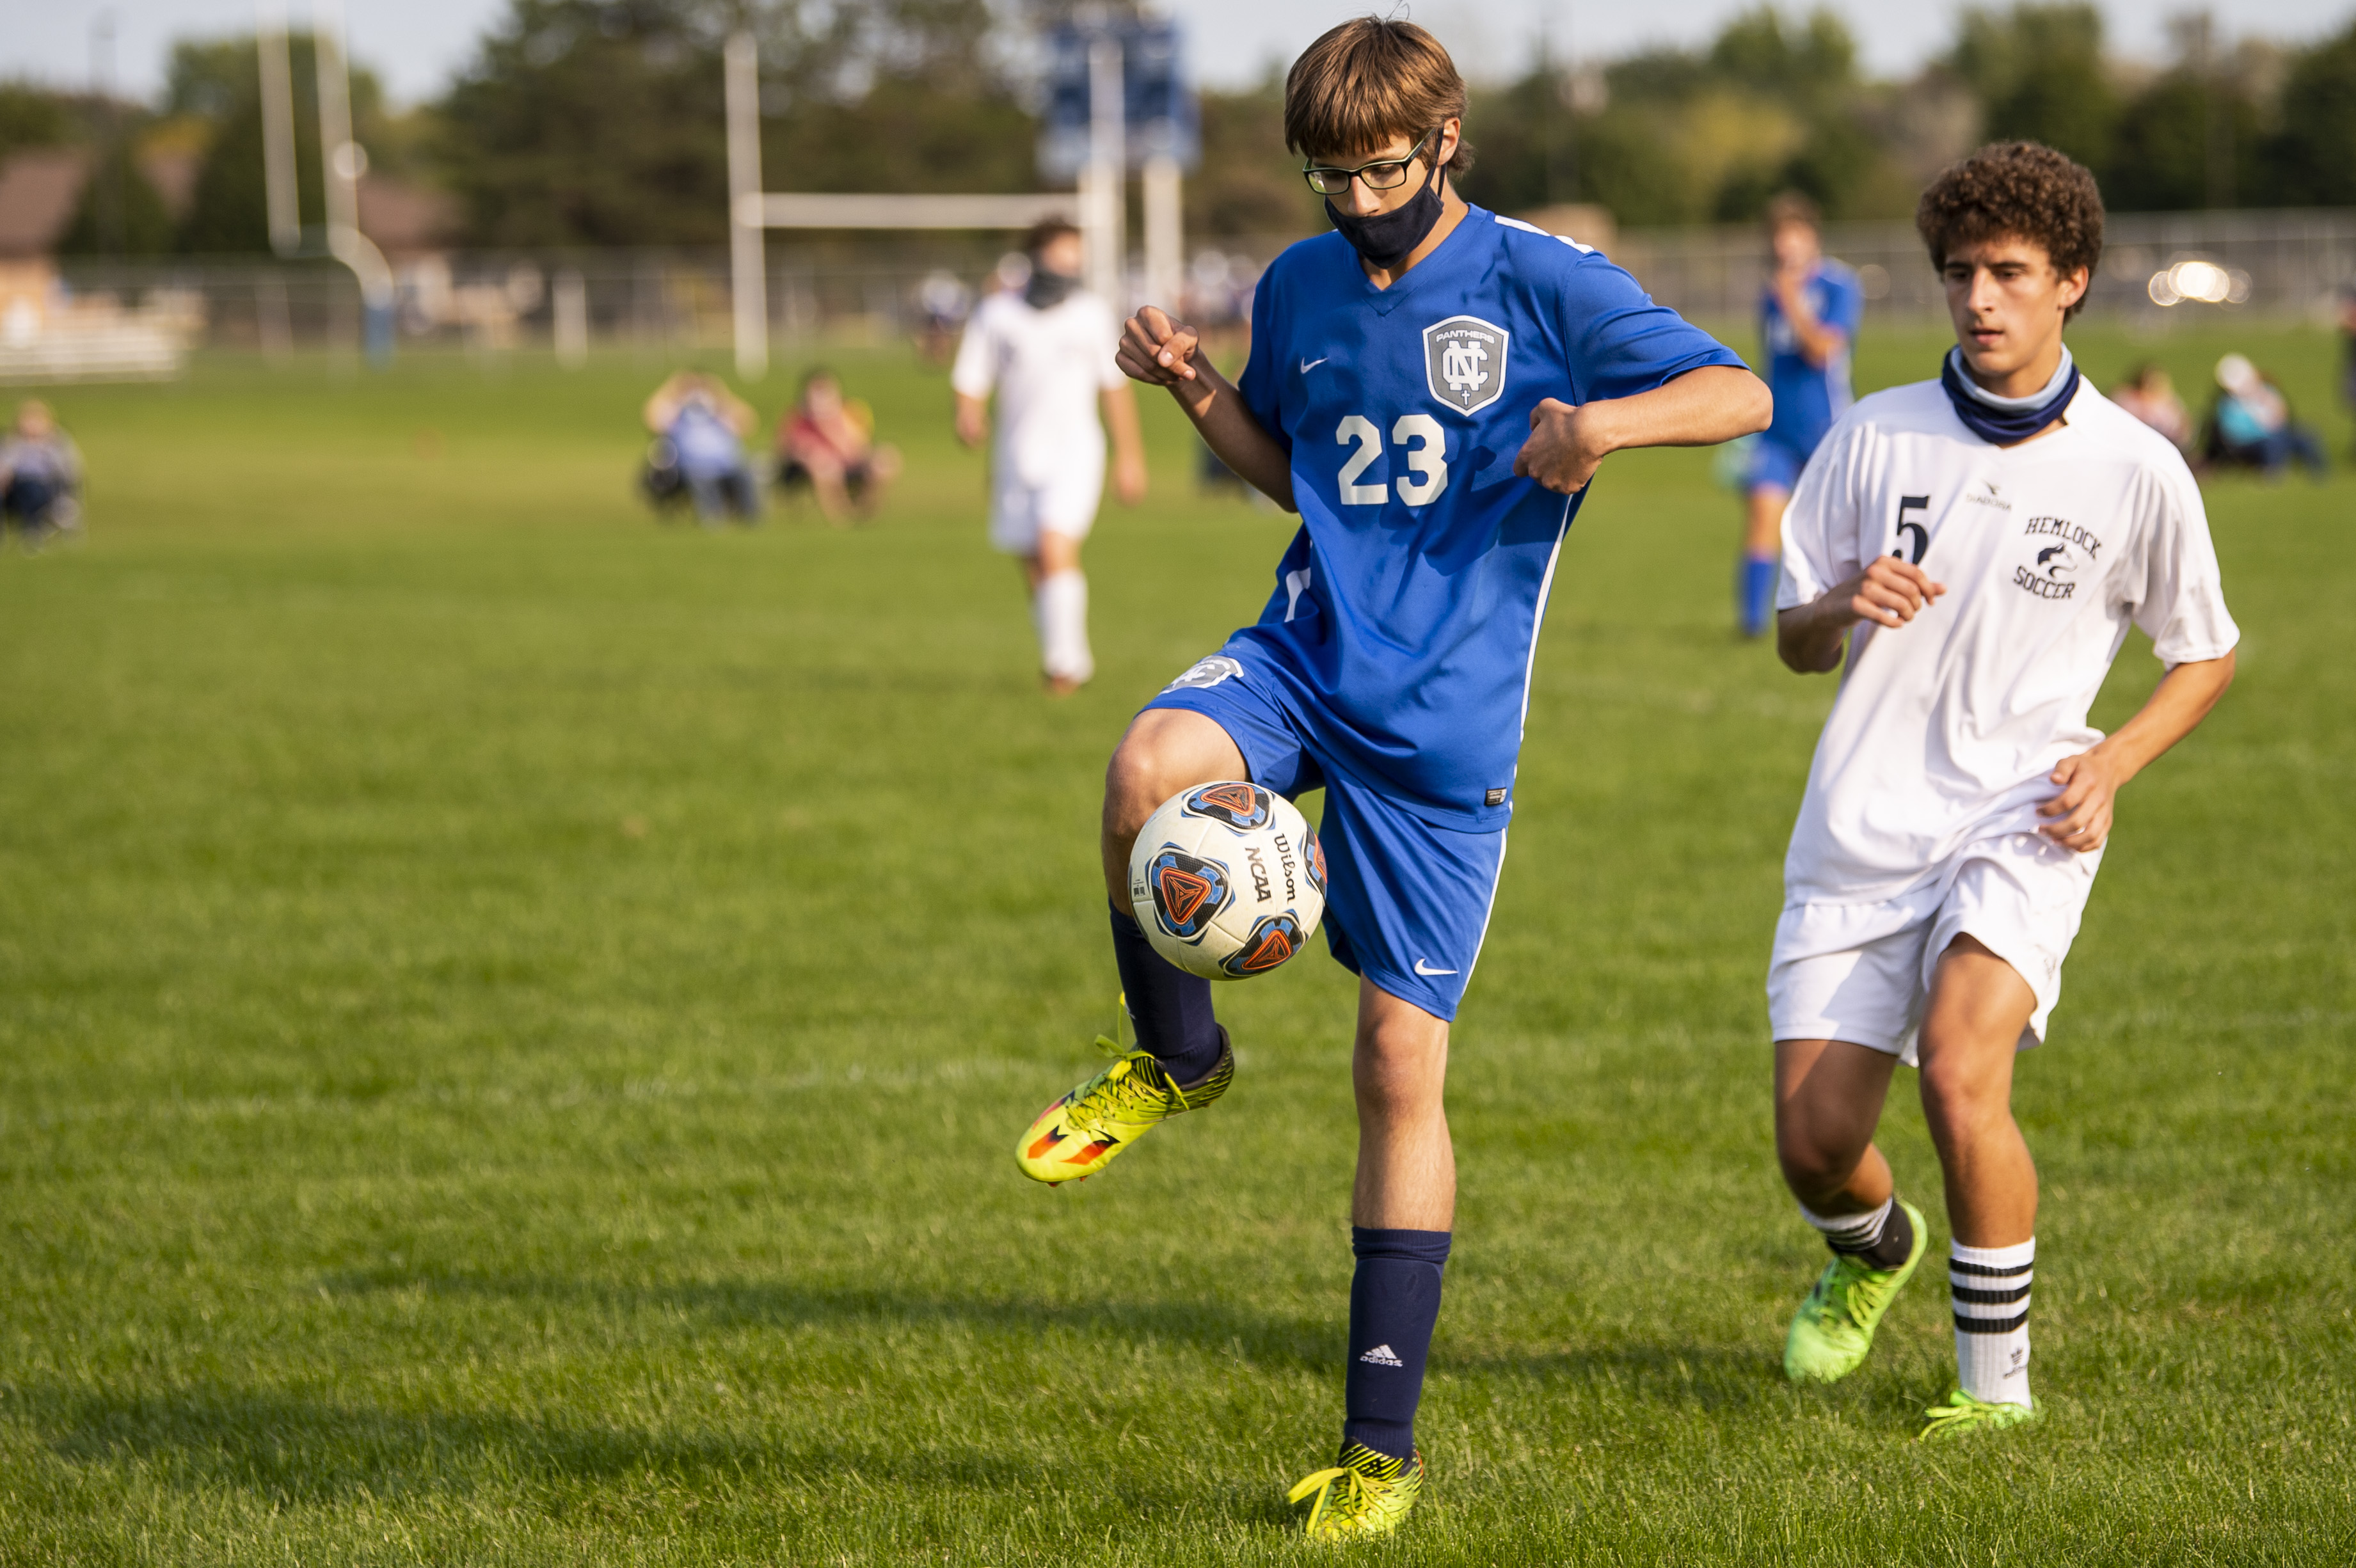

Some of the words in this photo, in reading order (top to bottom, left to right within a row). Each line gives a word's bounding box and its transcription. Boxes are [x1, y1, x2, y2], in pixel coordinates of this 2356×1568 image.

[1436, 329, 1495, 344] PANTHERS
[1335, 414, 1448, 507] 23
[1891, 494, 1931, 566] 5
[2024, 517, 2103, 560] HEMLOCK
[2013, 566, 2076, 600] SOCCER
[1245, 846, 1273, 903] NCAA
[1274, 833, 1296, 905] Wilson
[1360, 1356, 1403, 1367] adidas
